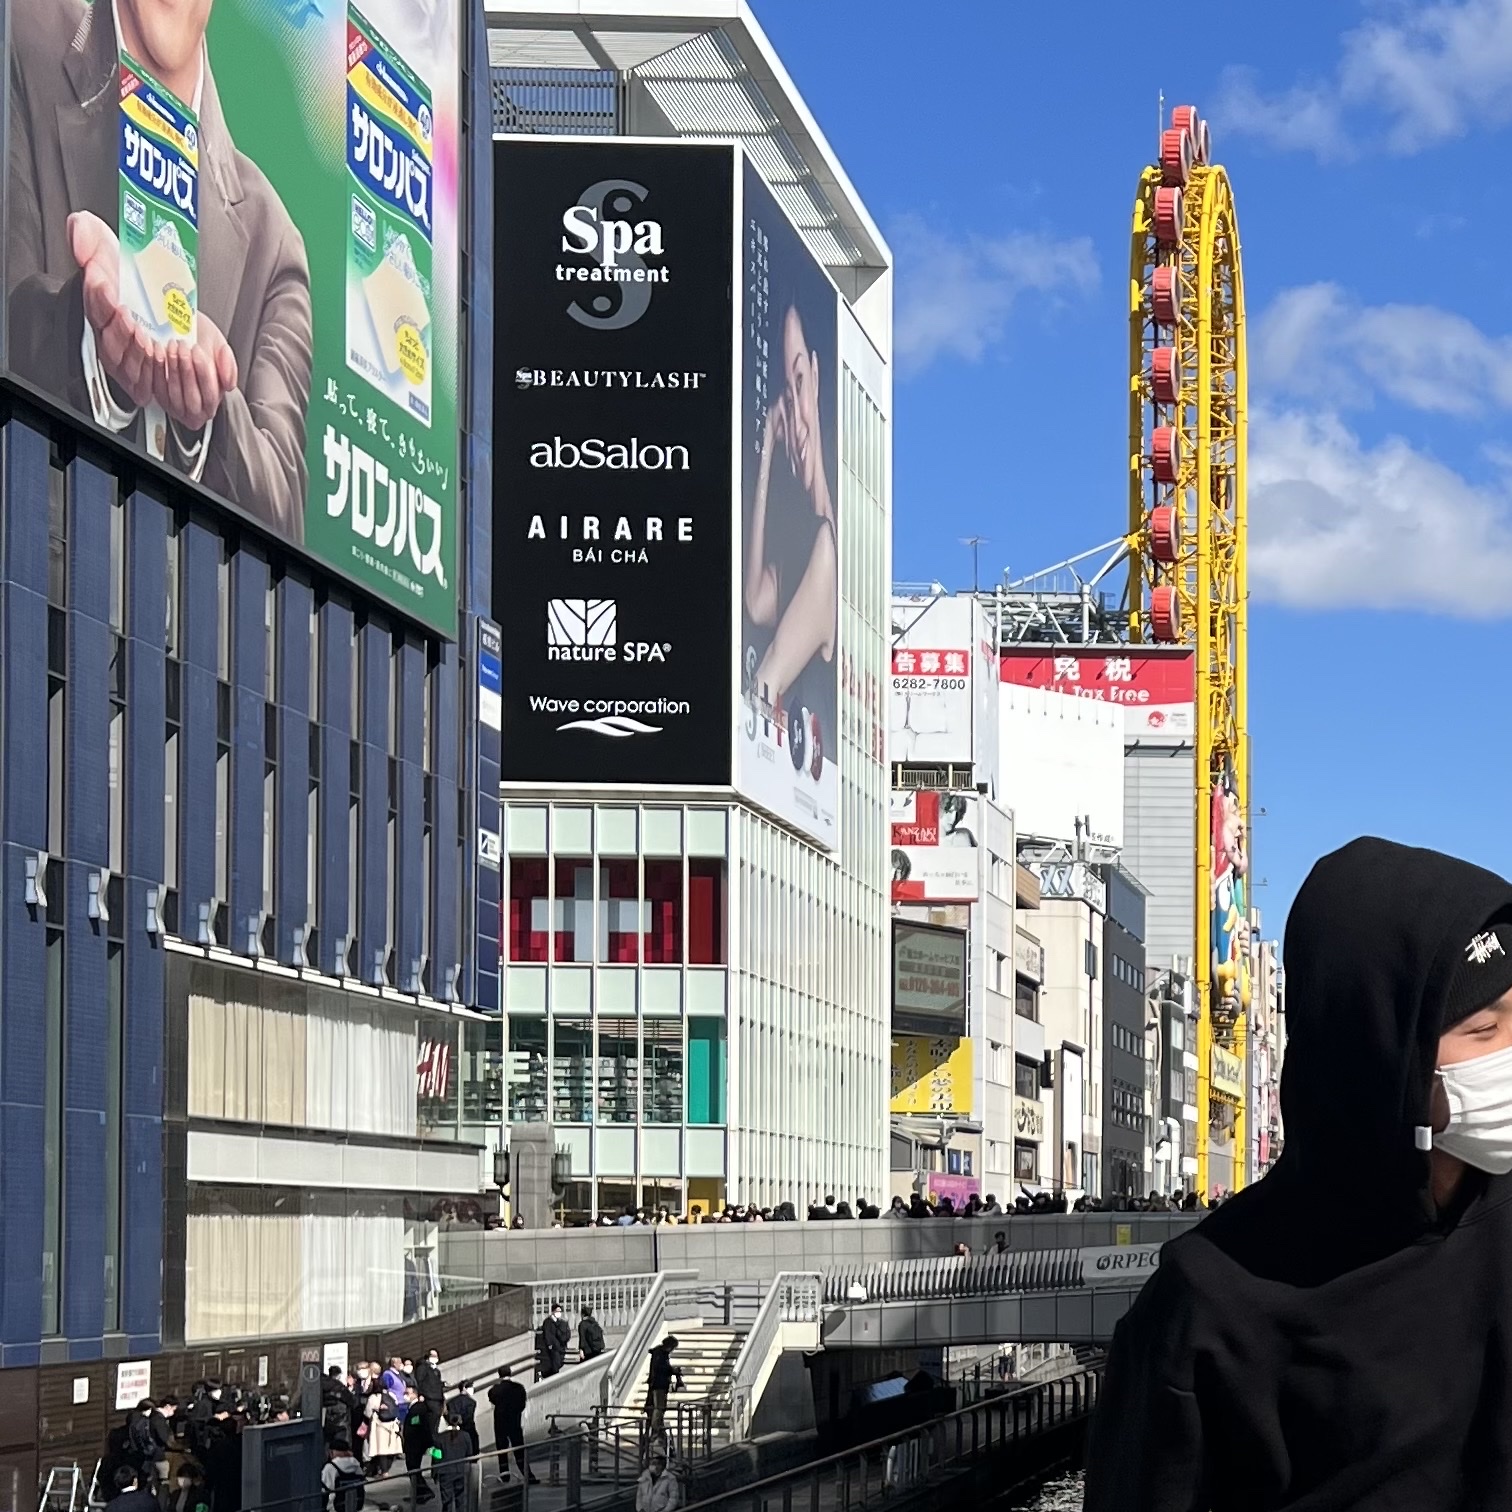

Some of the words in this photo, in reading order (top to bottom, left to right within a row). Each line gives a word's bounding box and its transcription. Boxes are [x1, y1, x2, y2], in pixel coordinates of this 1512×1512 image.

[124, 123, 196, 219] サロンパス
[352, 102, 427, 232] サロンパス
[562, 205, 664, 268] Spa
[555, 263, 670, 283] treatment
[533, 369, 699, 389] BEAUTYLASH
[529, 436, 690, 470] abSalon
[323, 424, 444, 588] サロンパス
[527, 515, 694, 541] AIRARE
[573, 547, 603, 563] BÁI
[610, 547, 649, 563] CHÁ
[548, 643, 617, 662] nature
[895, 651, 965, 673] 告募集
[1054, 655, 1133, 682] 免税
[892, 678, 965, 690] 6282-7800
[1110, 686, 1150, 703] Free
[529, 696, 579, 713] Wave
[584, 696, 690, 715] corporation
